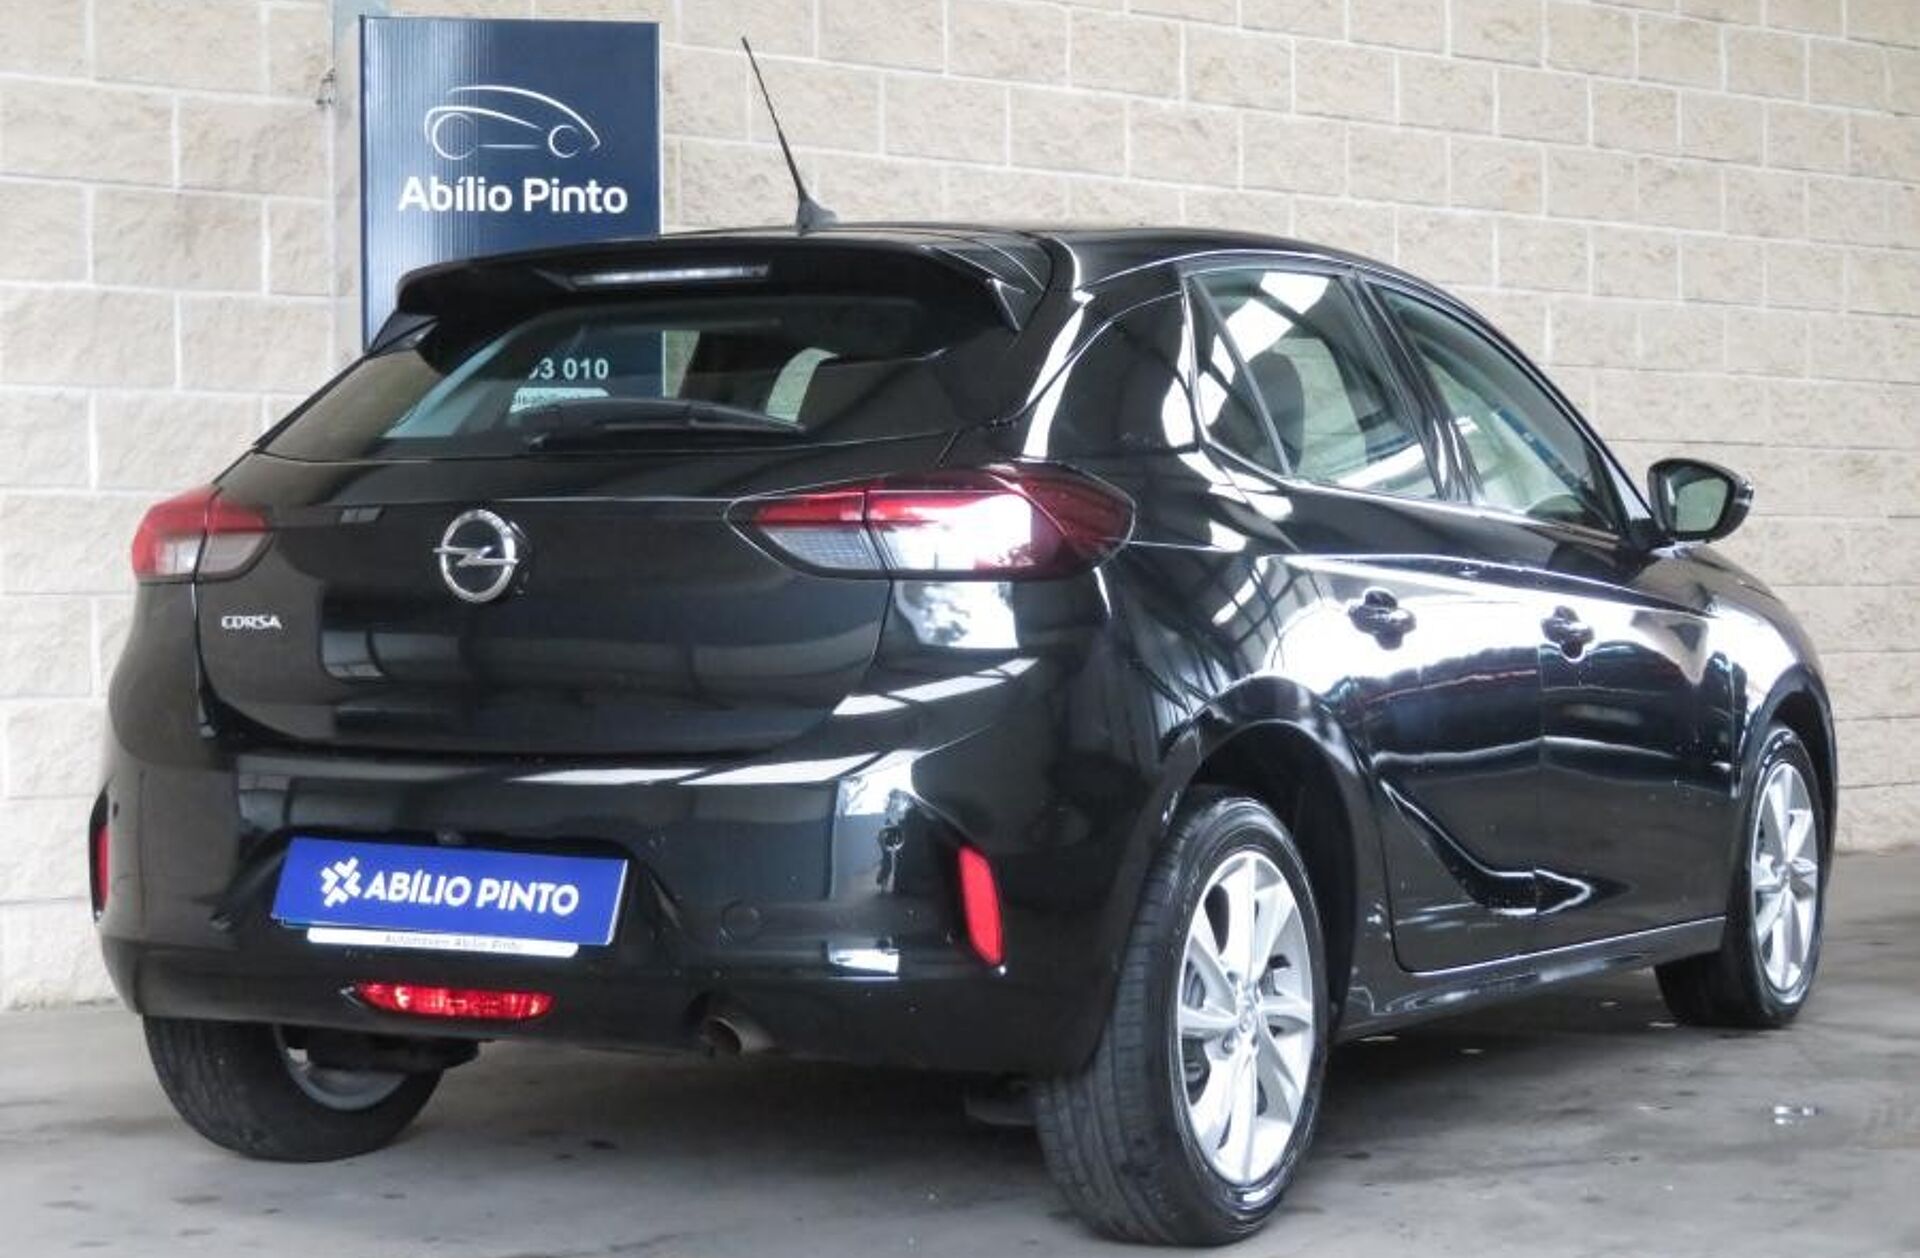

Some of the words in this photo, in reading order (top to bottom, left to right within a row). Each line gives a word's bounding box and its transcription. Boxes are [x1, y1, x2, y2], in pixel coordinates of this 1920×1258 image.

[399, 175, 513, 213] Abílio
[523, 177, 628, 214] Pinto
[562, 357, 609, 380] 010
[221, 615, 282, 630] CORSA
[363, 869, 472, 907] ABÍLIO
[475, 877, 579, 916] PINTO
